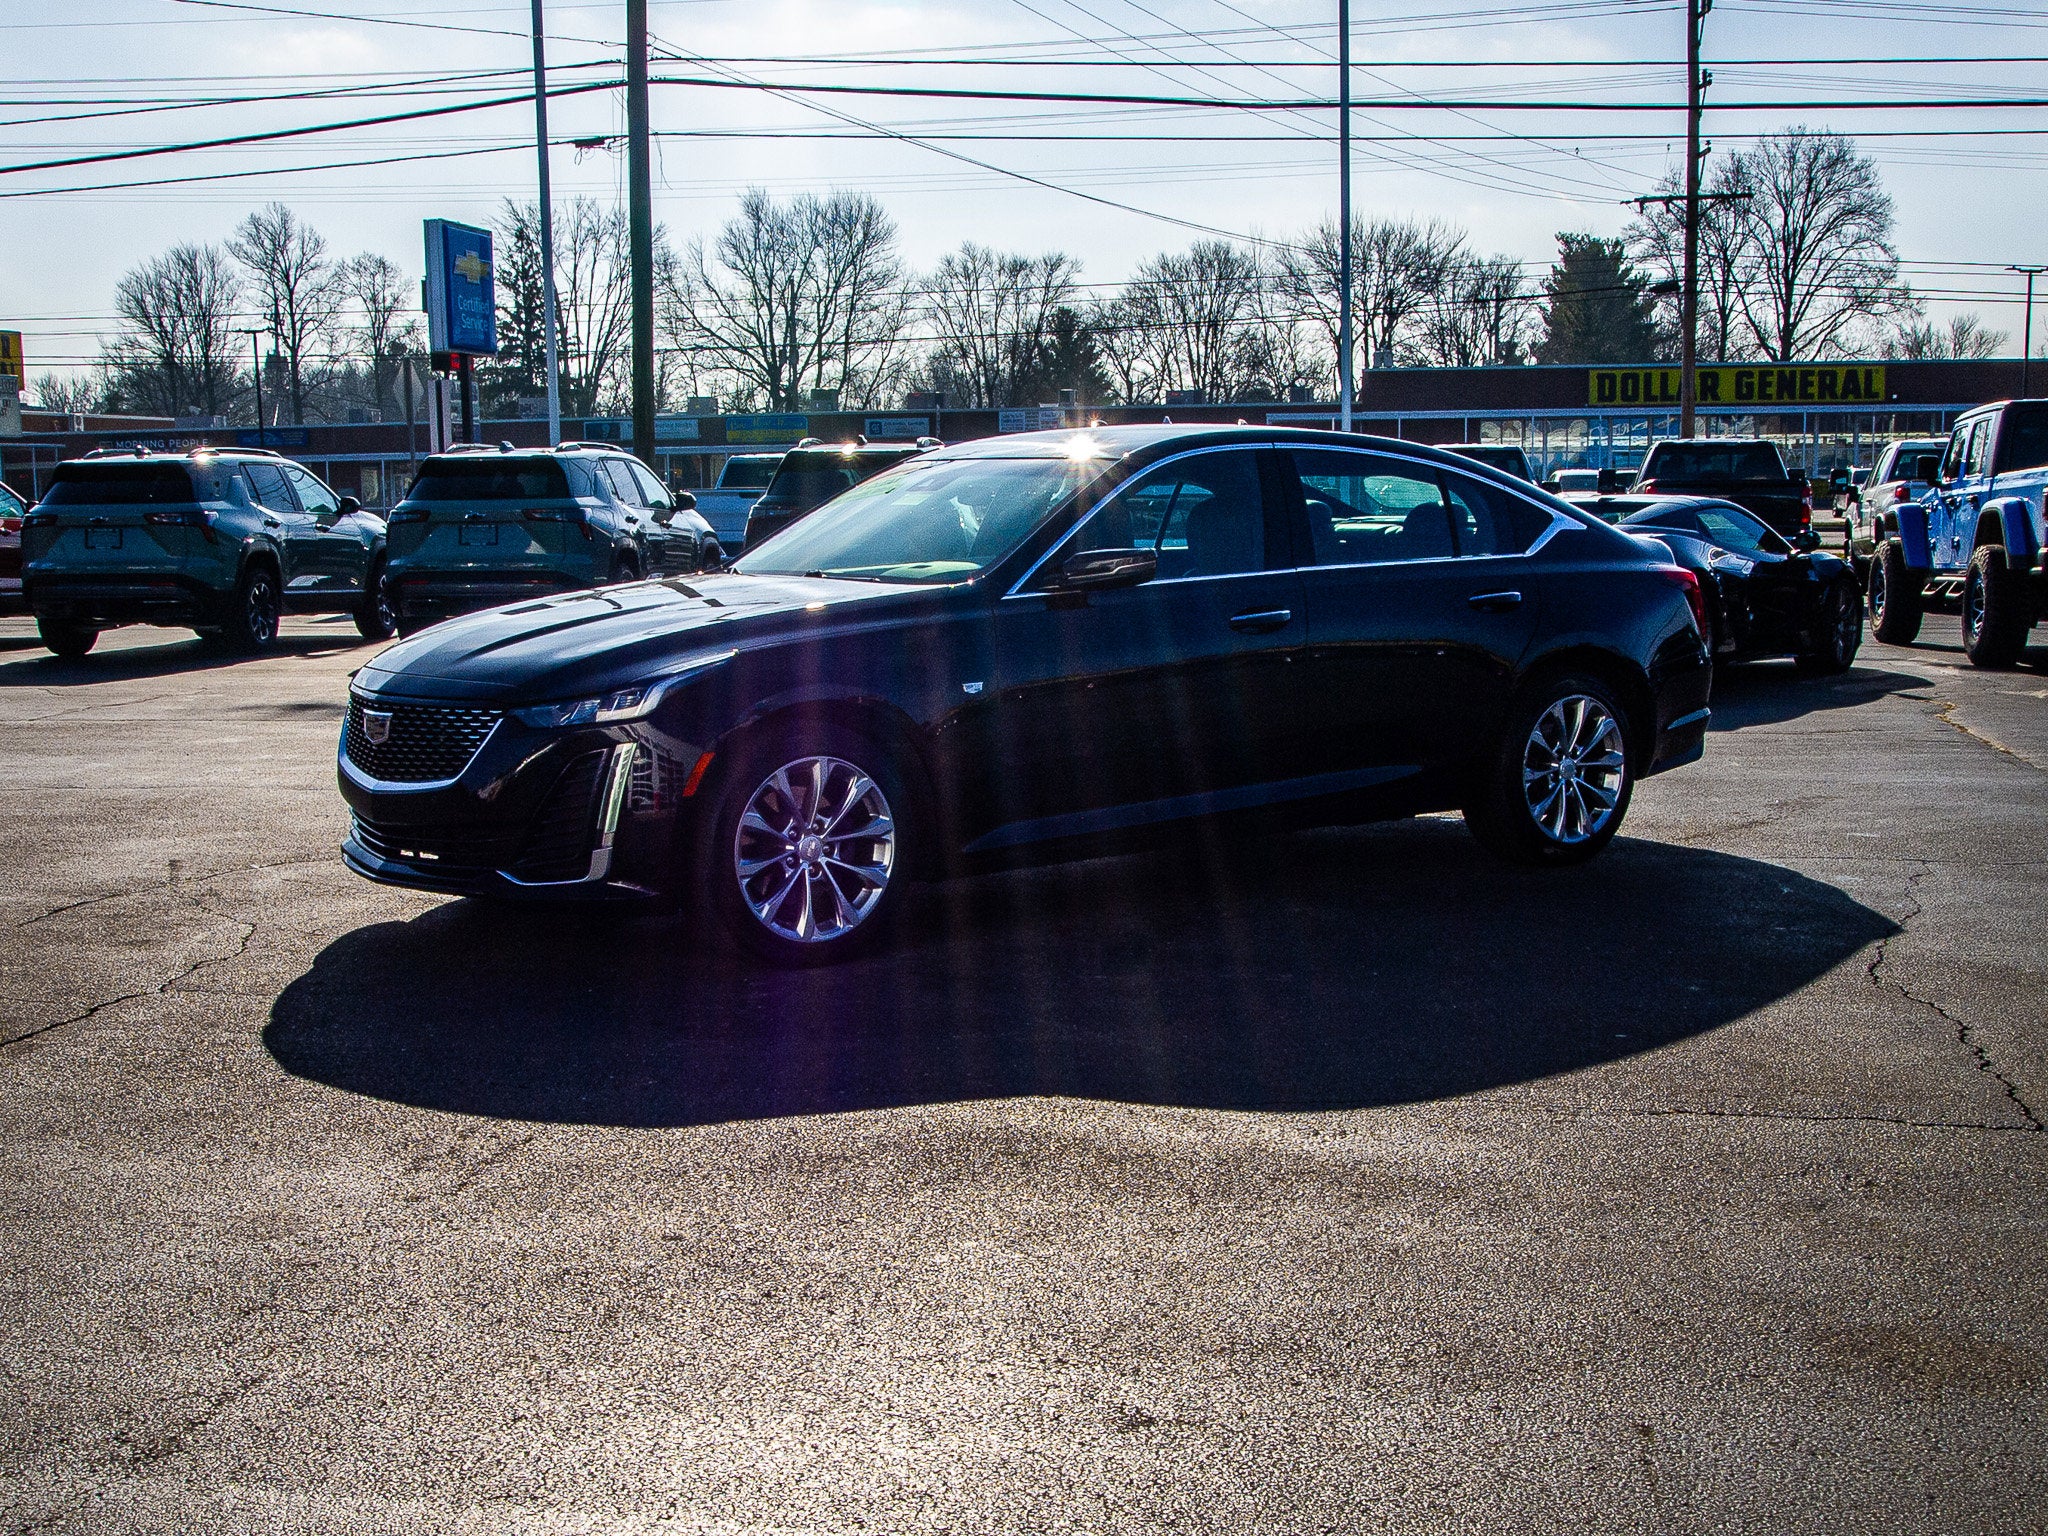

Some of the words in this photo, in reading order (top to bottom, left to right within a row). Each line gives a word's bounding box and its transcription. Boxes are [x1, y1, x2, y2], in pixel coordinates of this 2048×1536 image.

[458, 295, 490, 314] Certified
[461, 313, 488, 331] Service
[1735, 369, 1879, 400] GENERAL
[116, 439, 165, 449] MORNING
[168, 438, 209, 448] PEOPLE
